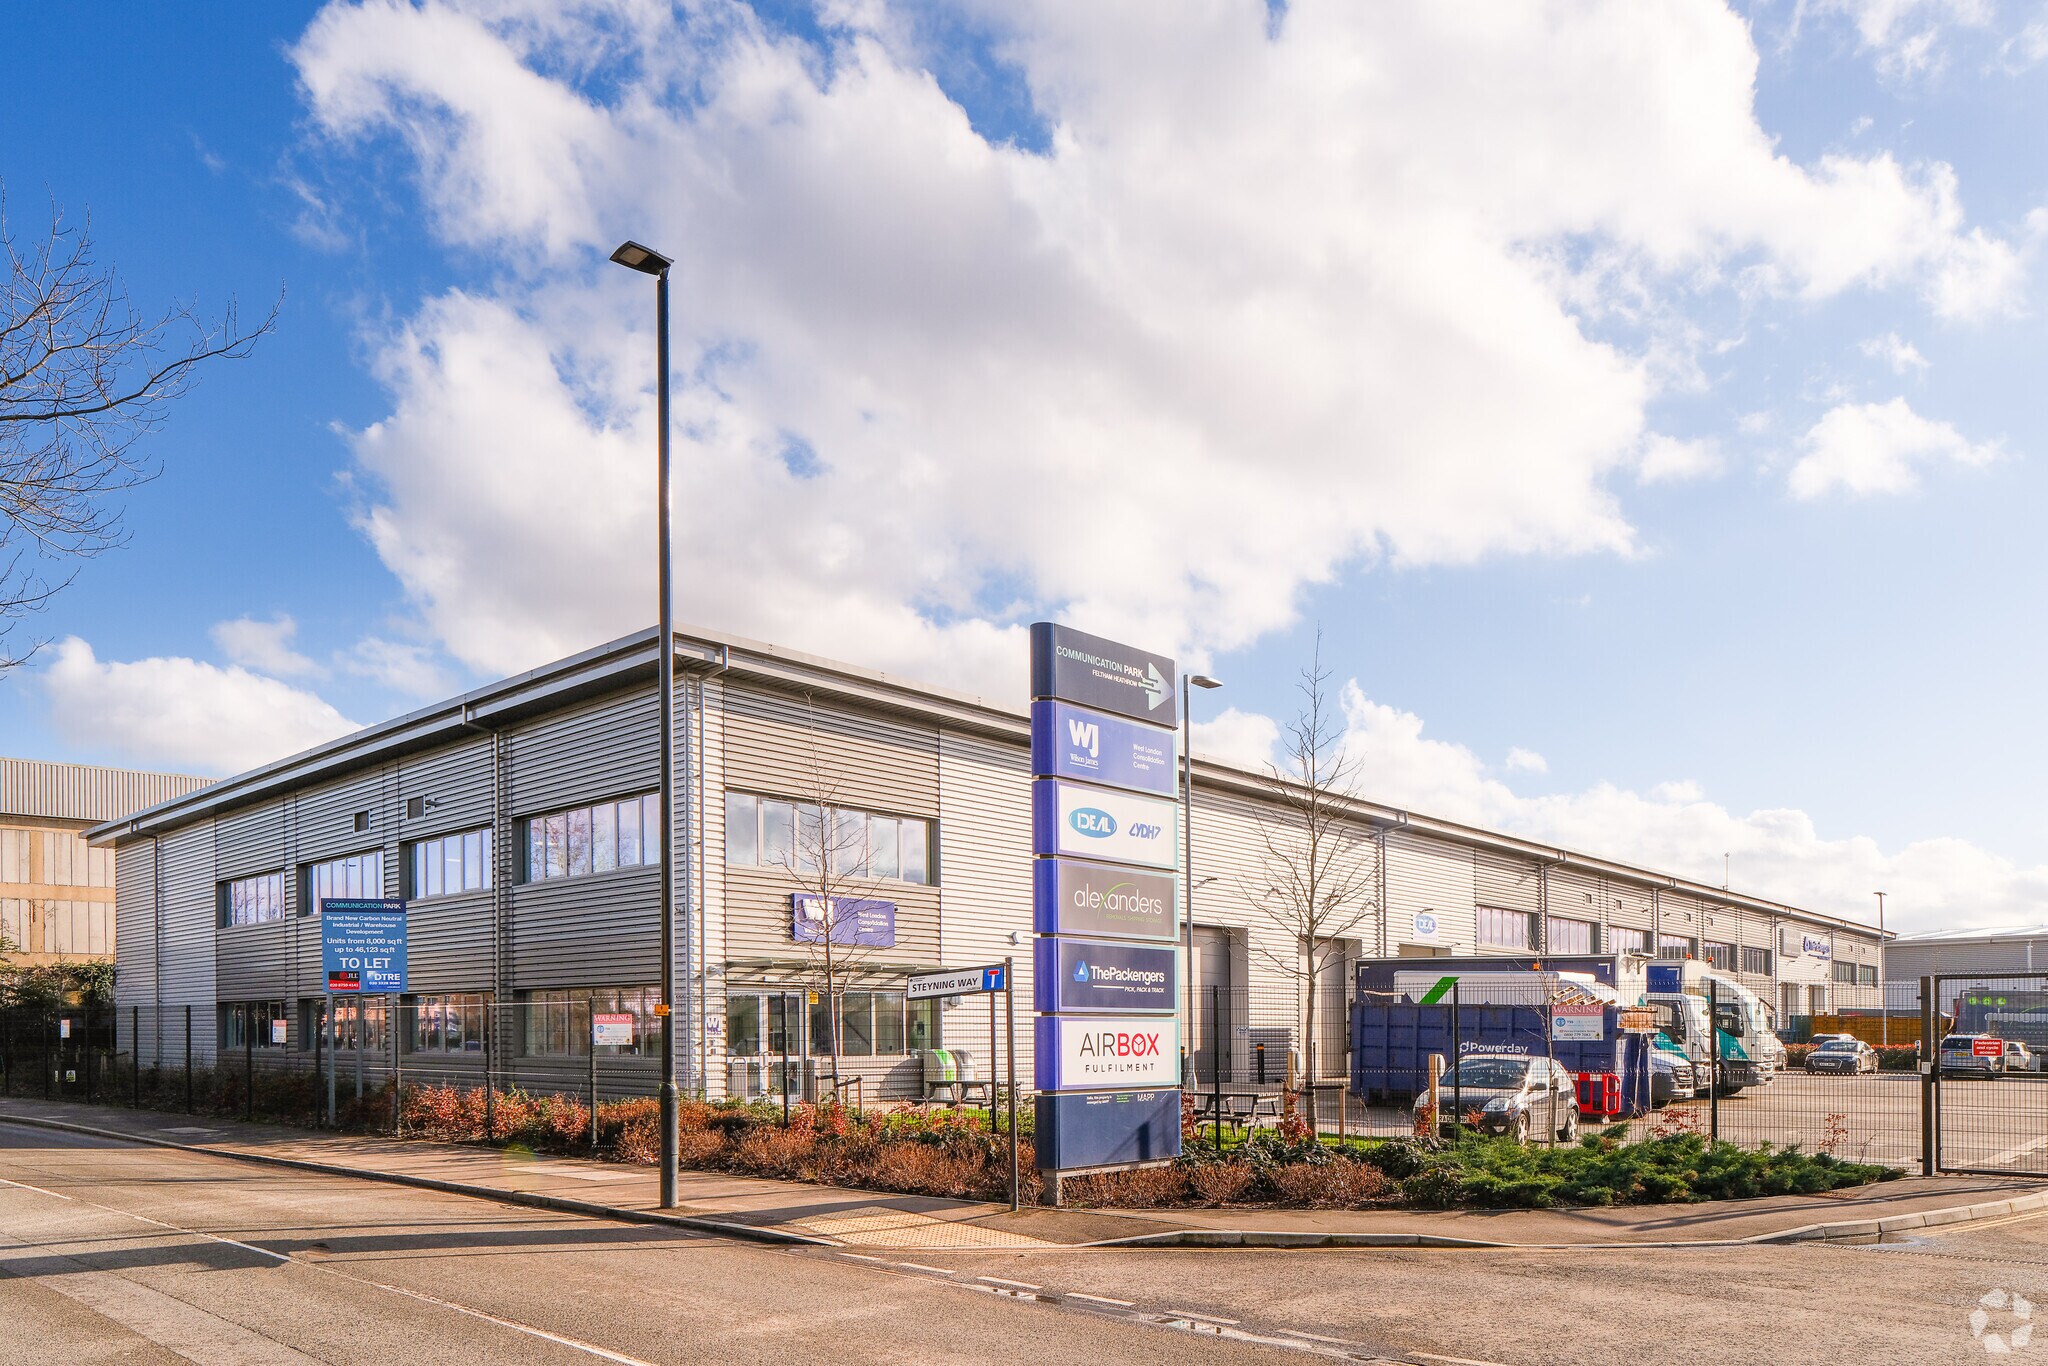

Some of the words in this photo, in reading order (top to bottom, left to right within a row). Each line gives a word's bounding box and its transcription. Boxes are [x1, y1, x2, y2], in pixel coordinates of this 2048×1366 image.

[1056, 645, 1123, 673] COMMUNICATION
[1123, 664, 1143, 678] PARK
[1092, 669, 1113, 680] FELTHAM
[1113, 675, 1138, 687] HEATHROW
[1069, 718, 1099, 758] WJ
[1133, 743, 1144, 752] West
[1145, 746, 1162, 756] London
[1070, 753, 1085, 763] Wilson
[1085, 756, 1099, 766] James
[1133, 752, 1165, 765] Consolidation
[1133, 761, 1150, 771] Centre
[1077, 812, 1111, 833] IDEAL
[1074, 883, 1163, 915] alexanders
[858, 918, 889, 927] Consolidation
[869, 912, 888, 920] London
[339, 957, 360, 969] TO
[364, 957, 391, 969] LET
[374, 973, 401, 981] DTRE
[1090, 965, 1165, 985] ThePackengers
[912, 979, 956, 993] STEYNING
[957, 977, 979, 988] WAY
[1553, 1006, 1601, 1014] WARNING
[1080, 1033, 1159, 1057] AIRBOX
[1470, 1041, 1529, 1055] Powerday
[1085, 1062, 1155, 1073] FULFILMENT
[1137, 1093, 1155, 1102] MAPP
